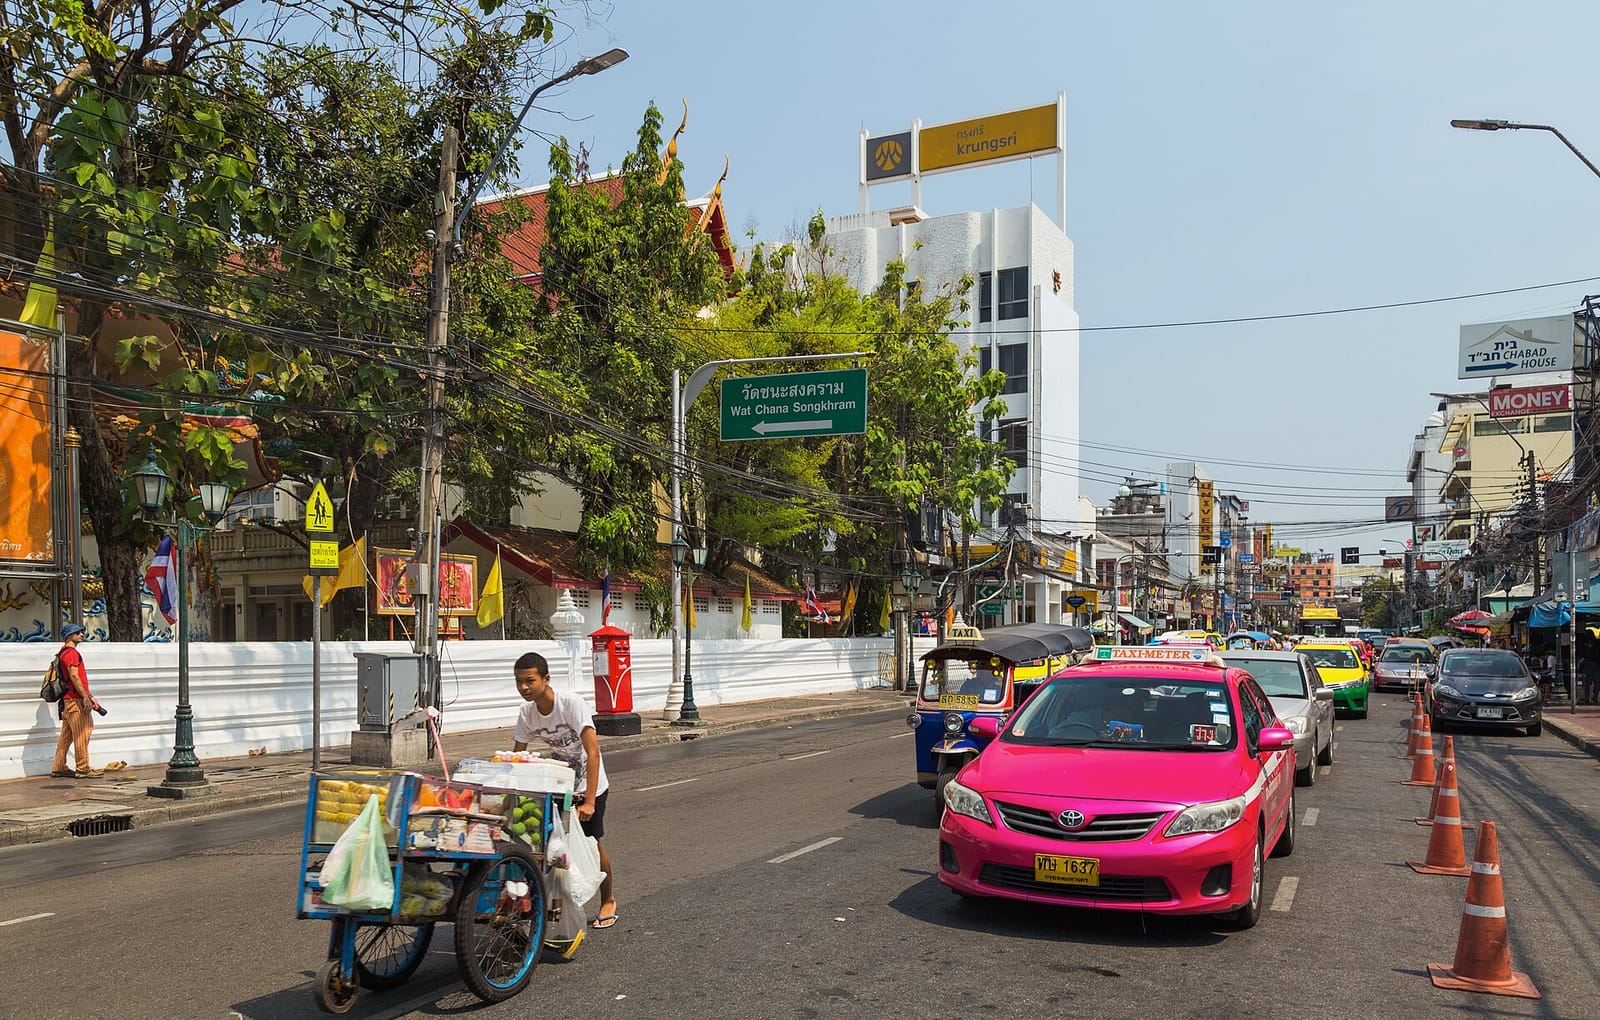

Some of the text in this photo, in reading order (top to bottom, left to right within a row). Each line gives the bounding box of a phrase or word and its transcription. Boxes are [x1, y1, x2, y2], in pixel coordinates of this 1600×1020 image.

[958, 132, 1016, 155] krungsri
[1494, 340, 1518, 351] בית
[1503, 347, 1547, 360] CHABAD
[1520, 357, 1557, 369] HOUSE
[742, 382, 843, 400] วัดชนะสงคราม
[1493, 390, 1565, 410] MONEY
[731, 400, 855, 417] Wat Chana Songkhram
[1491, 408, 1531, 417] EXCHANGE
[952, 628, 974, 638] TAXI
[1112, 649, 1191, 660] TAXI-METER
[956, 695, 977, 705] 5813
[1064, 860, 1096, 875] 1637
